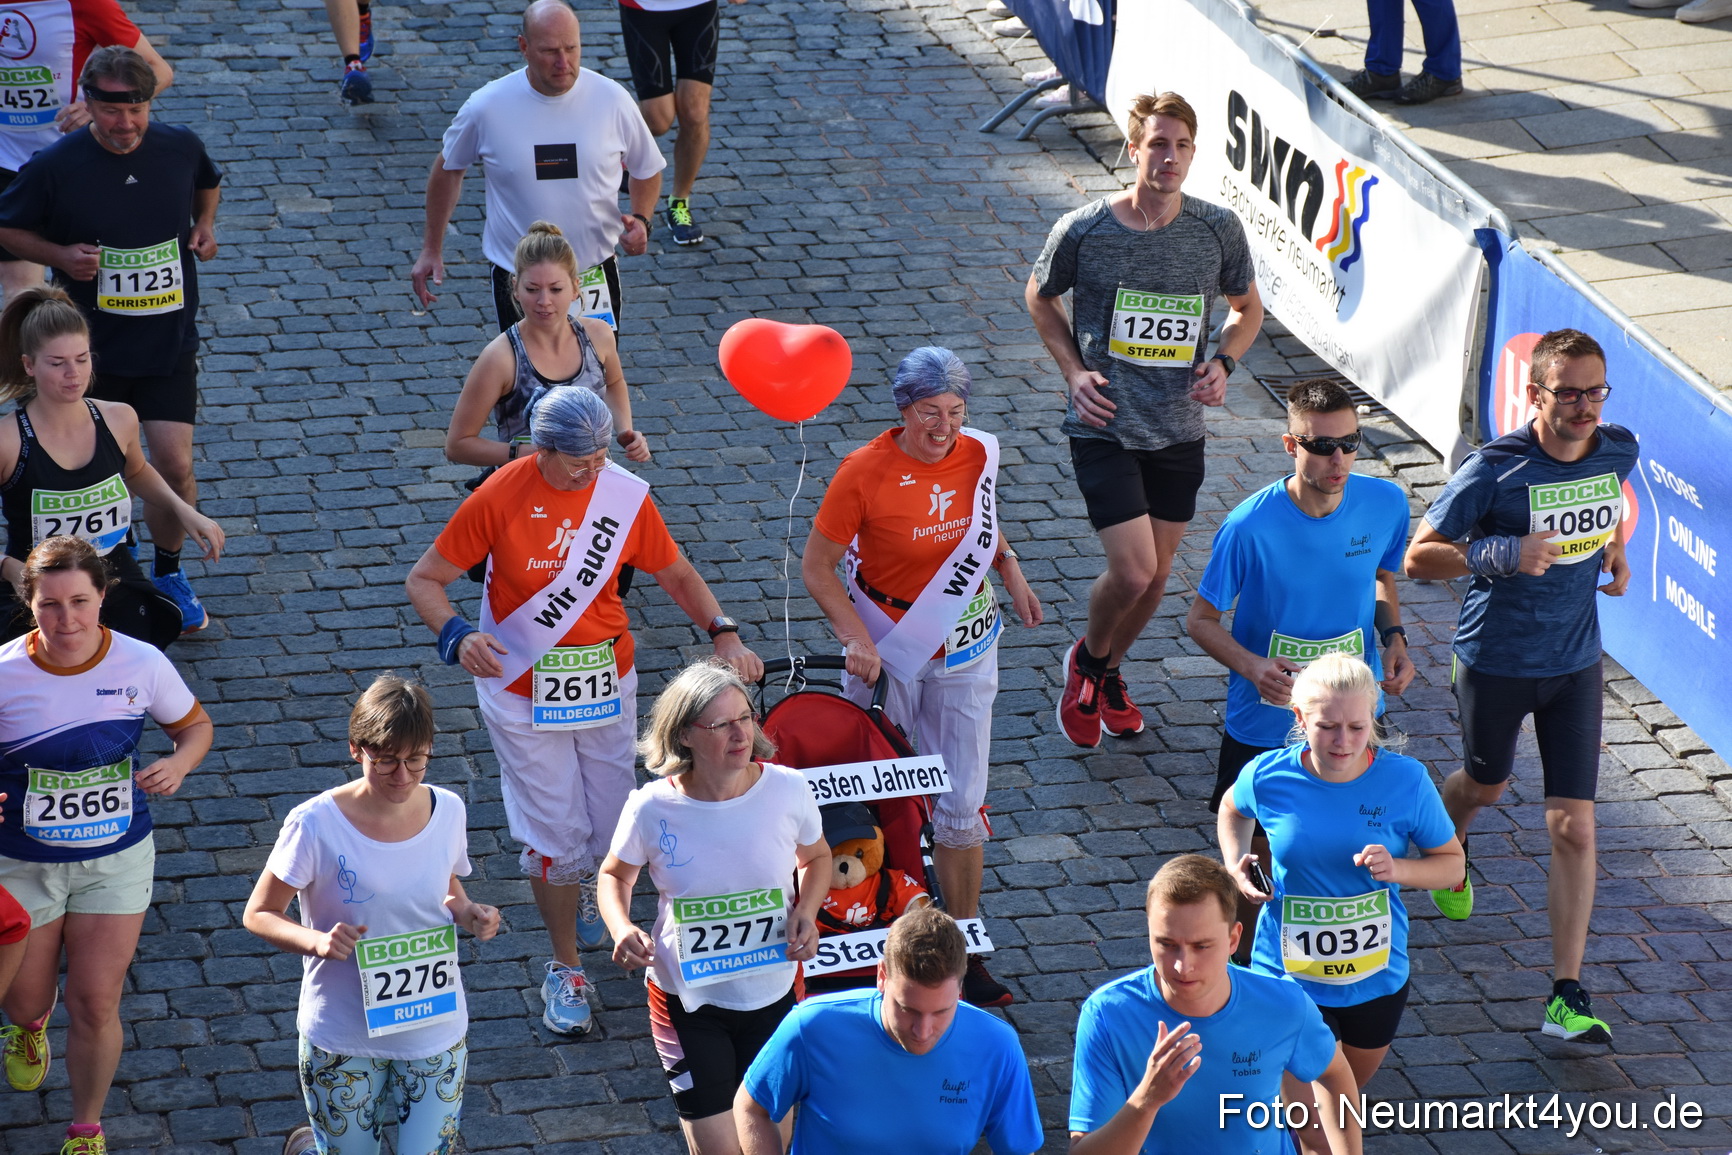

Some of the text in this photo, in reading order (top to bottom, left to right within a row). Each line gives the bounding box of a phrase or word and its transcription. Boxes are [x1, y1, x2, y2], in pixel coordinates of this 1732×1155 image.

[0, 67, 46, 84] OCK
[0, 88, 51, 109] 452
[9, 114, 38, 124] RUDI
[1226, 89, 1324, 243] swn
[105, 243, 174, 267] BOCK
[1220, 174, 1287, 252] stadtwerke
[1288, 239, 1346, 313] neumarkt
[109, 267, 174, 293] 1123
[107, 293, 176, 308] CHRISTIAN
[1121, 292, 1197, 314] BOCK
[1124, 316, 1190, 342] 1263
[1127, 346, 1177, 358] STEFAN
[40, 480, 122, 512] BOCK
[1537, 477, 1616, 508] BOCK
[1650, 459, 1703, 510] STORE
[45, 506, 118, 538] 2761
[912, 515, 972, 541] funrunner
[1543, 505, 1612, 536] 1080
[943, 476, 993, 597] wir auch
[1562, 538, 1600, 555] LRICH
[1669, 515, 1717, 577] ONLINE
[1345, 547, 1372, 558] Matthias
[533, 516, 620, 629] wir auch
[1666, 575, 1716, 640] MOBILE
[540, 644, 612, 669] BOCK
[969, 630, 995, 658] LUISE
[544, 671, 612, 702] 2613
[543, 703, 615, 720] HILDEGARD
[808, 763, 944, 800] esten Jahren
[38, 787, 120, 821] 2666
[38, 821, 120, 840] KATARINA
[1367, 820, 1382, 828] Eva
[681, 889, 777, 920] BOCK
[1290, 895, 1382, 922] BOCK
[364, 929, 450, 965] BOCK
[688, 916, 774, 954] 2277
[1296, 923, 1379, 957] 1032
[691, 948, 780, 975] KATHARINA
[1323, 963, 1357, 975] EVA
[374, 960, 448, 1001] 2276
[394, 1001, 433, 1021] RUTH
[1232, 1068, 1262, 1077] Tobias
[939, 1095, 968, 1104] Florian
